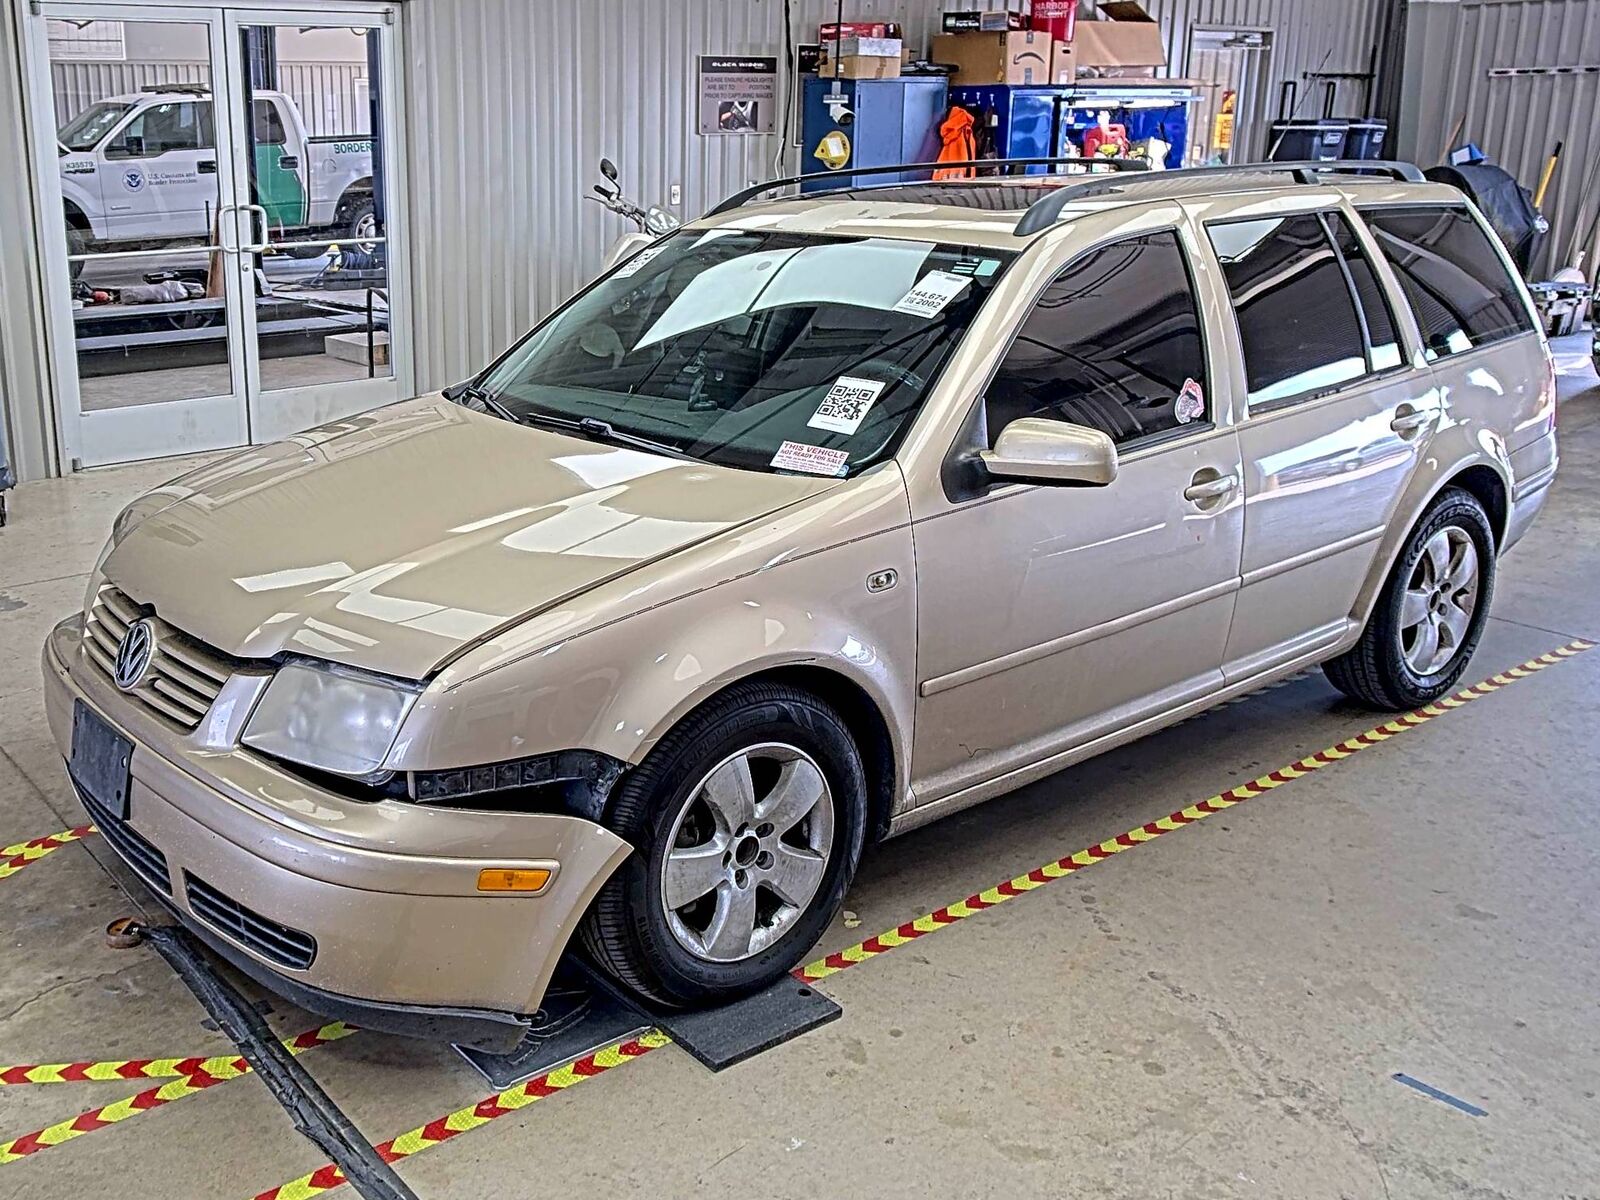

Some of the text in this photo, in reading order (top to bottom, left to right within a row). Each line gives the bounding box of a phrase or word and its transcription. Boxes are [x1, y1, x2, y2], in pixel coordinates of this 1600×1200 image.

[1034, 2, 1069, 10] HARBOR
[333, 142, 372, 154] BORDER
[916, 299, 941, 309] 2002
[784, 443, 848, 459] THIS VEHICLE
[793, 450, 813, 458] READY
[827, 456, 844, 465] SALE
